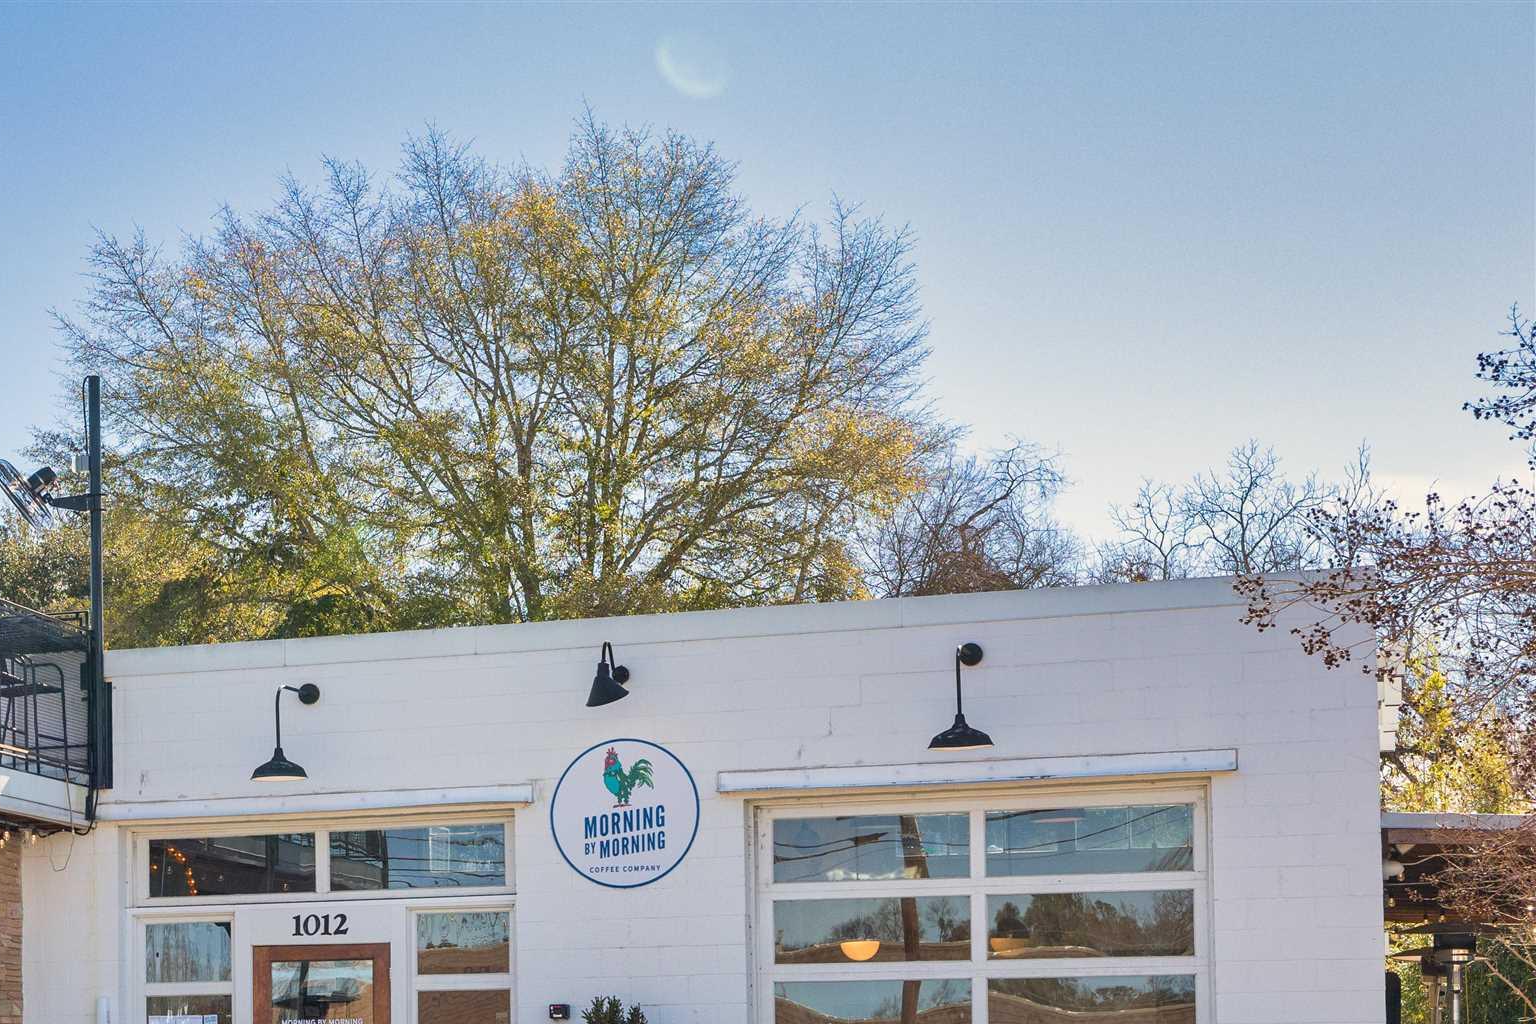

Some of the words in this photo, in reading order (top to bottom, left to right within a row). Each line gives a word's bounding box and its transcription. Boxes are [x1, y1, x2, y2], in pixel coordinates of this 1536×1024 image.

[584, 804, 666, 839] MORNING
[584, 842, 596, 856] BY
[599, 831, 666, 859] MORNING
[589, 866, 620, 874] COFFEE
[623, 865, 662, 873] COMPANY
[292, 913, 349, 937] 1012
